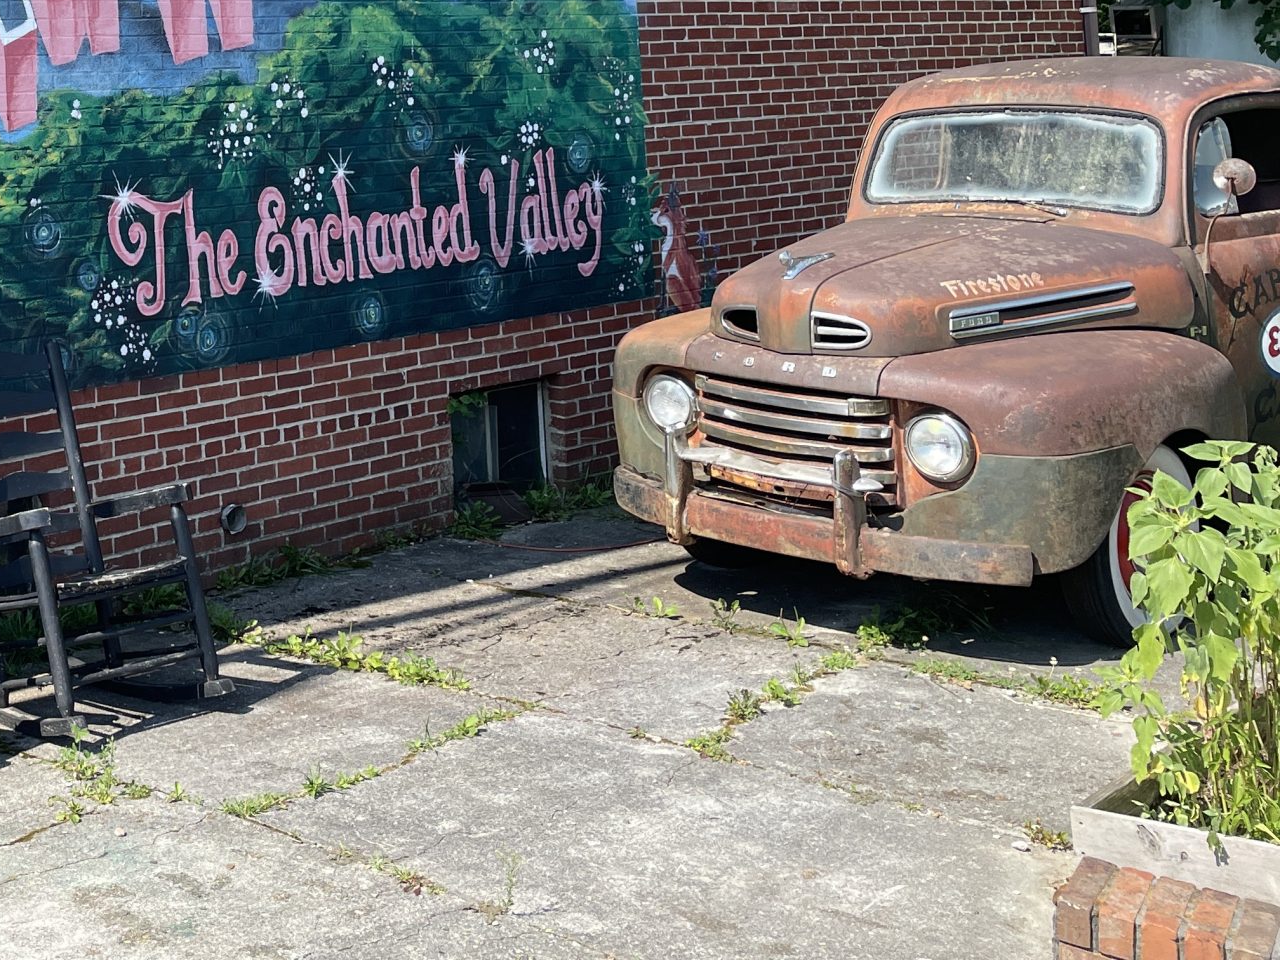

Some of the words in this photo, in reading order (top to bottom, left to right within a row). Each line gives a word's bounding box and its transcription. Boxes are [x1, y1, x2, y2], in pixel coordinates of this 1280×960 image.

[107, 187, 248, 316] The
[254, 152, 479, 297] Enchanted
[478, 146, 605, 277] Valley
[940, 271, 1045, 299] Firestone
[712, 351, 837, 378] FORD
